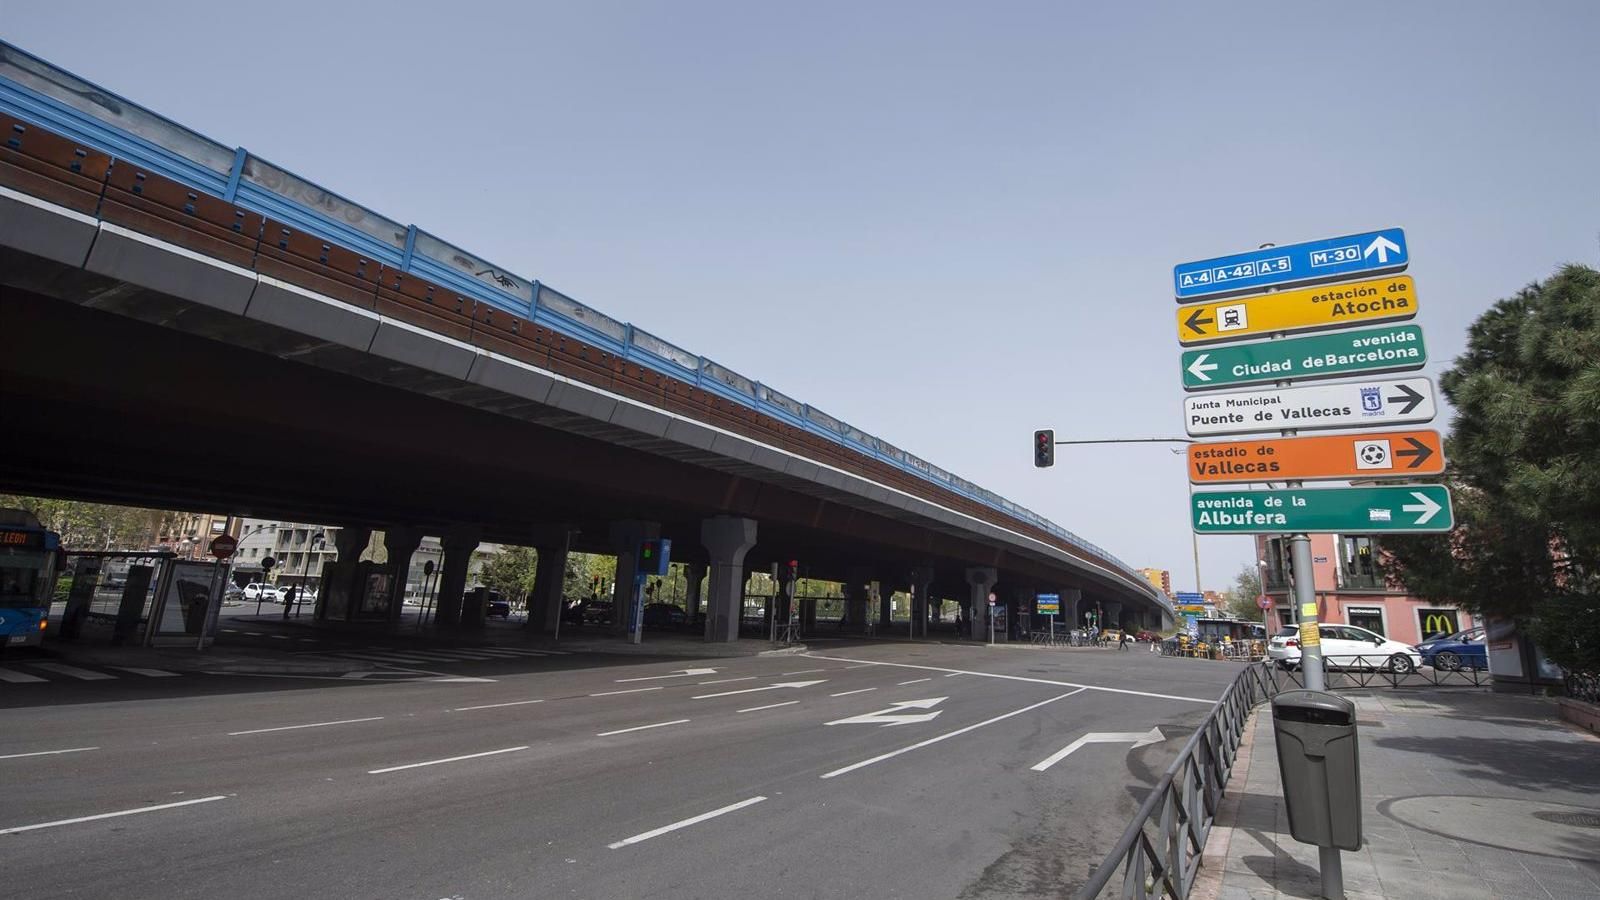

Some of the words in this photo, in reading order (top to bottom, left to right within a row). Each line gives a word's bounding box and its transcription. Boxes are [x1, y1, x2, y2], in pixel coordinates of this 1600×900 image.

[1182, 273, 1209, 286] A-4
[1216, 265, 1254, 280] A-42
[1260, 260, 1288, 273] A-5
[1314, 248, 1357, 264] M-30
[1312, 286, 1377, 304] estación
[1388, 282, 1407, 293] de
[1332, 296, 1409, 316] Atocha
[1353, 332, 1416, 348] avenida
[1232, 359, 1292, 377] Ciudad
[1192, 400, 1221, 410] Junta
[1226, 396, 1281, 408] Municipal
[1192, 413, 1244, 426] Puente
[1254, 410, 1273, 421] de
[1282, 405, 1351, 420] Vallecas
[1362, 409, 1385, 417] madrid
[1194, 447, 1247, 459] estadio
[1257, 445, 1275, 456] de
[1196, 458, 1280, 475] Vallecas
[1197, 497, 1253, 509] avenida
[1264, 496, 1282, 507] de
[1292, 496, 1306, 507] la
[1199, 510, 1287, 526] Albufera
